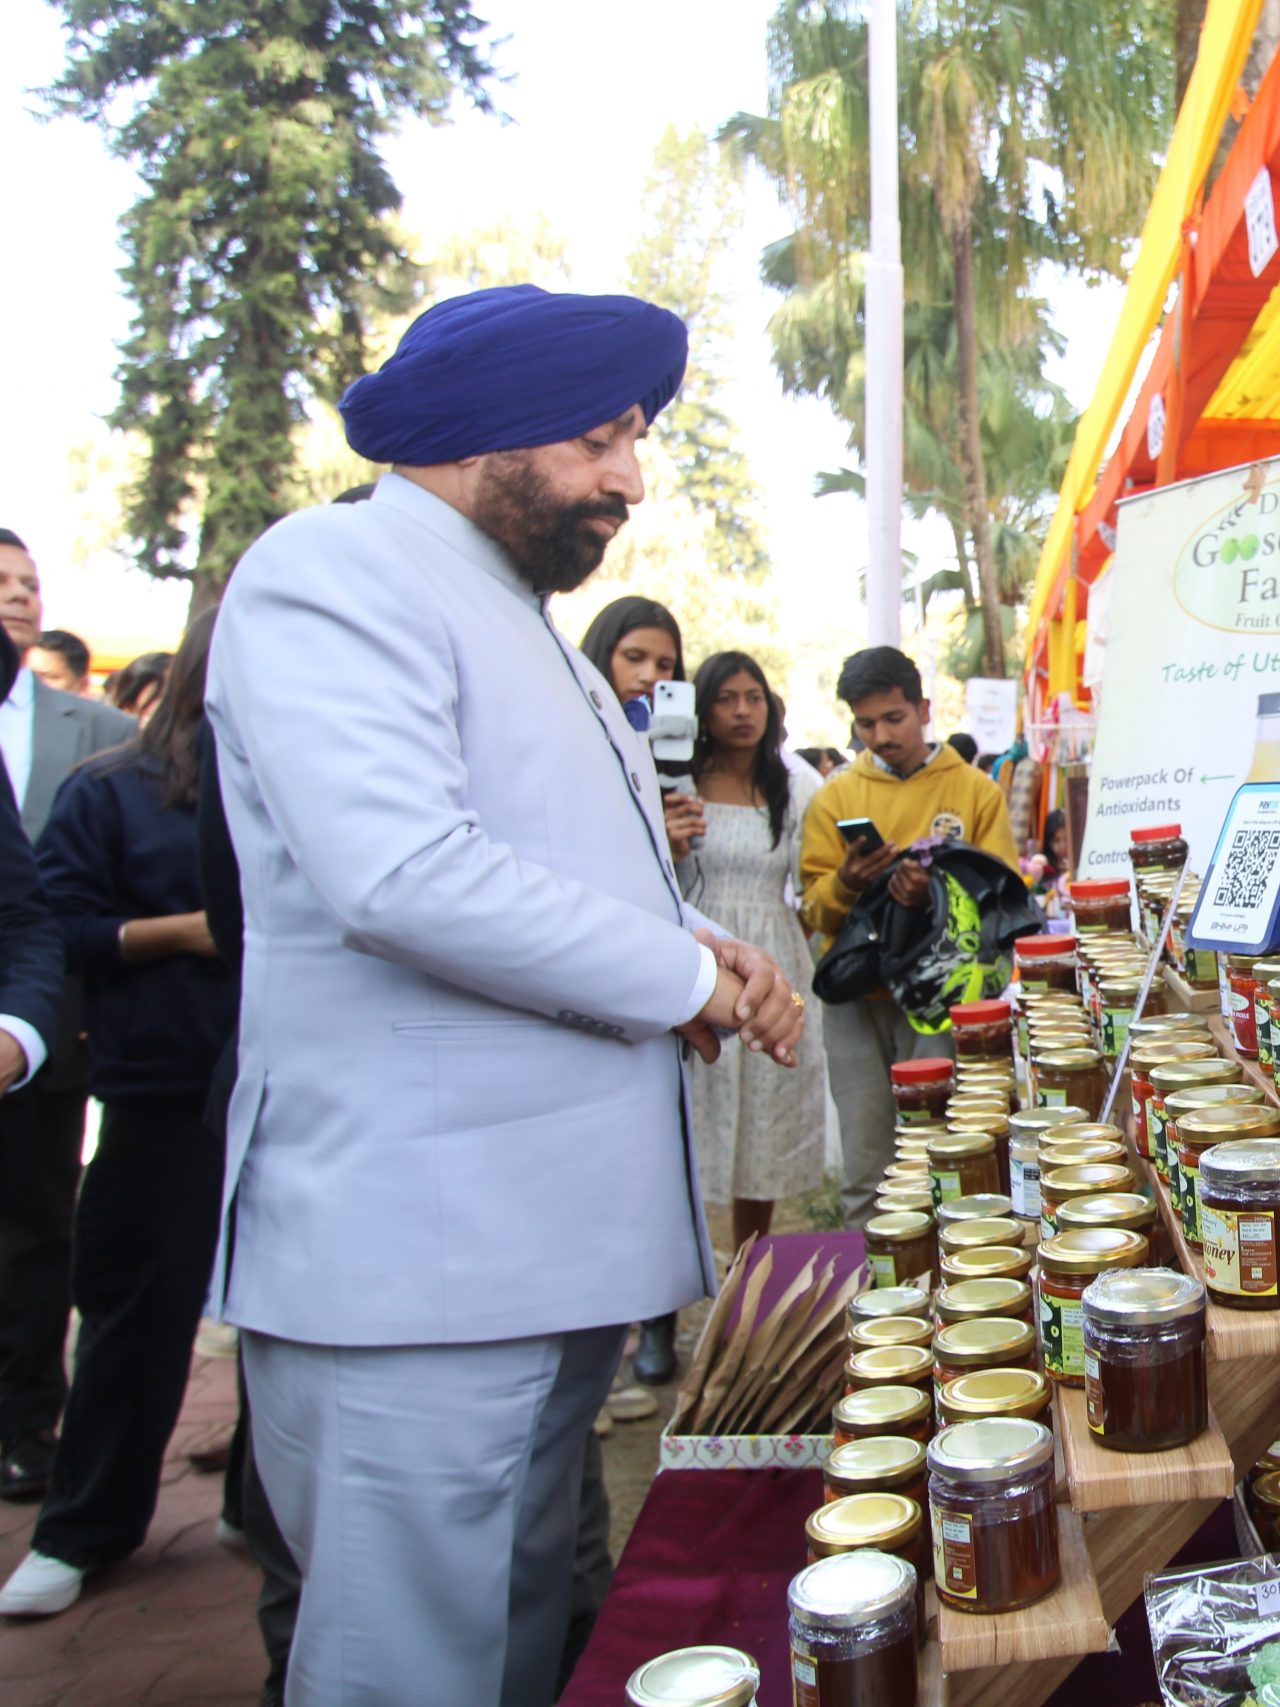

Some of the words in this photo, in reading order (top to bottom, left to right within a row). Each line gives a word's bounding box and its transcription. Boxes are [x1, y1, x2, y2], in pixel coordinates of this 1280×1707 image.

[1235, 612, 1271, 627] Fruit
[1162, 661, 1218, 683] Taste
[1223, 653, 1246, 681] of
[1100, 768, 1168, 792] Powerpack
[1174, 767, 1194, 784] Of
[1096, 797, 1181, 817] Antioxidants
[1087, 850, 1129, 866] Contro
